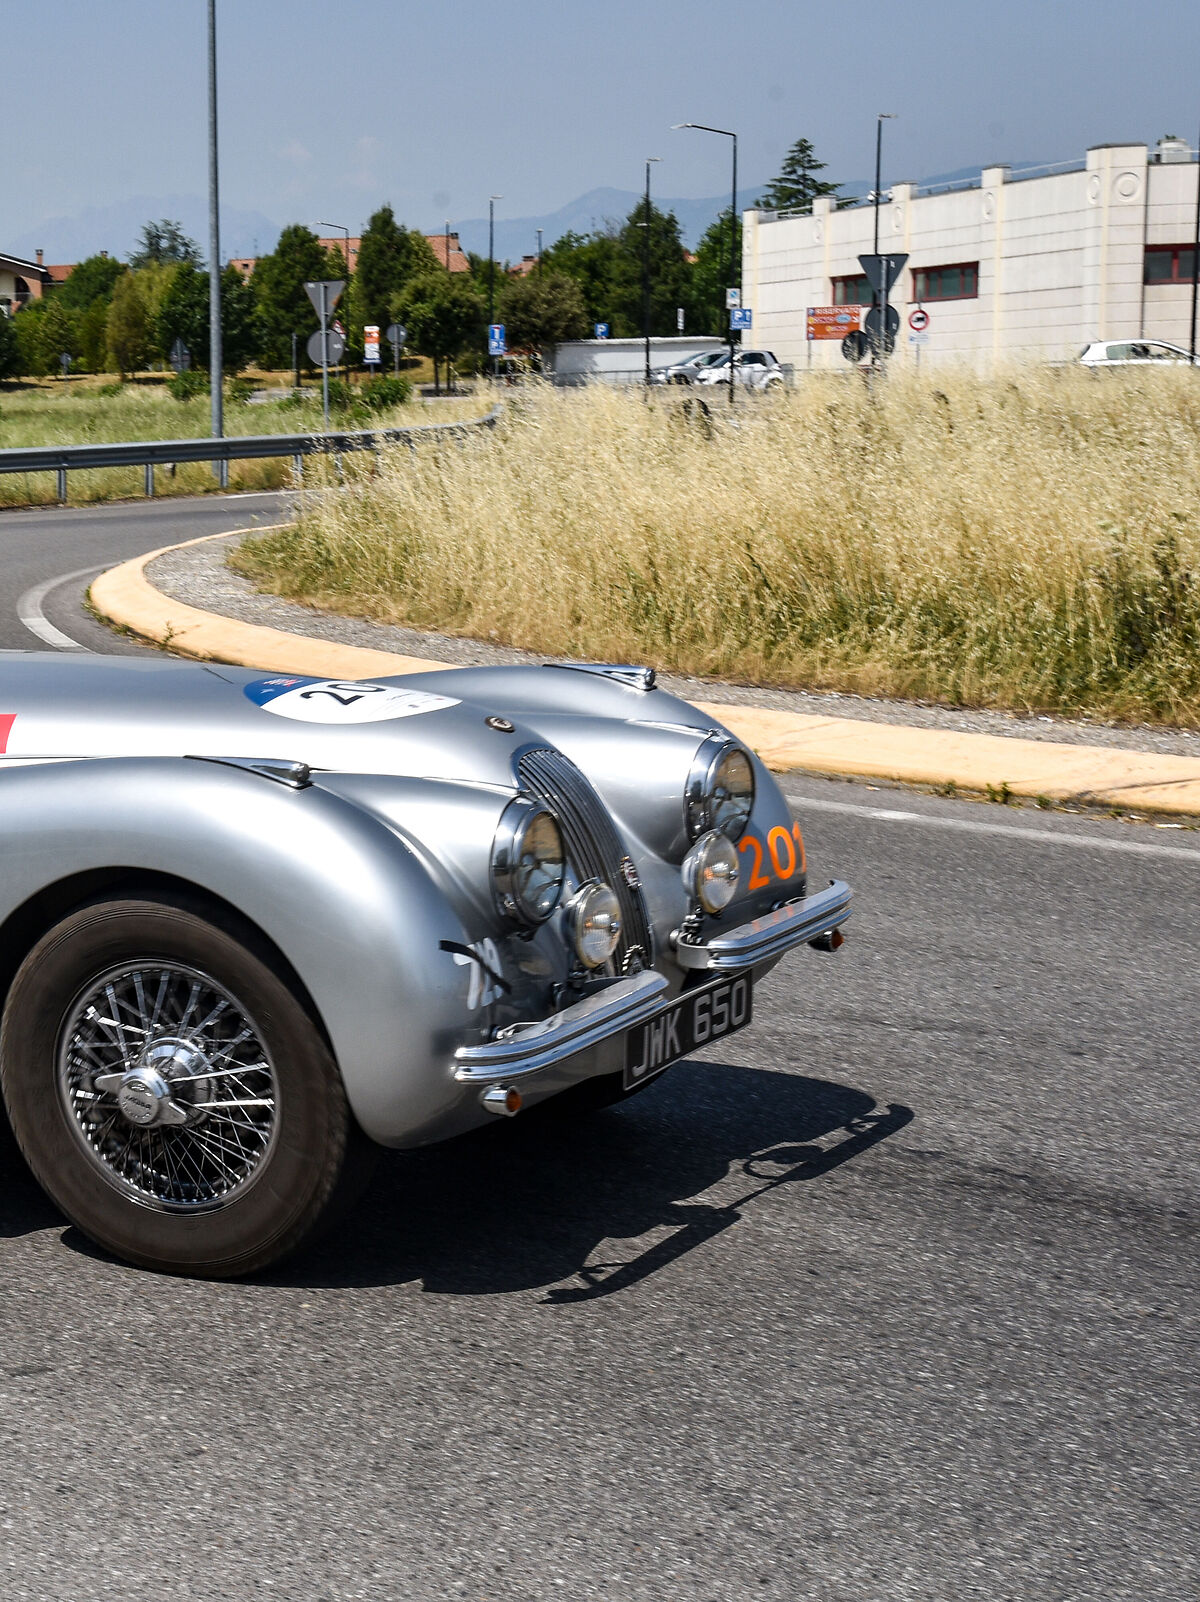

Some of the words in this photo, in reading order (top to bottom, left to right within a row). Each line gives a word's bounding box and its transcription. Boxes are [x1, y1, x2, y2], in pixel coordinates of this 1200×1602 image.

[300, 681, 386, 706] 20
[738, 820, 807, 891] 201
[631, 1006, 682, 1077] JWK
[693, 979, 747, 1044] 650
